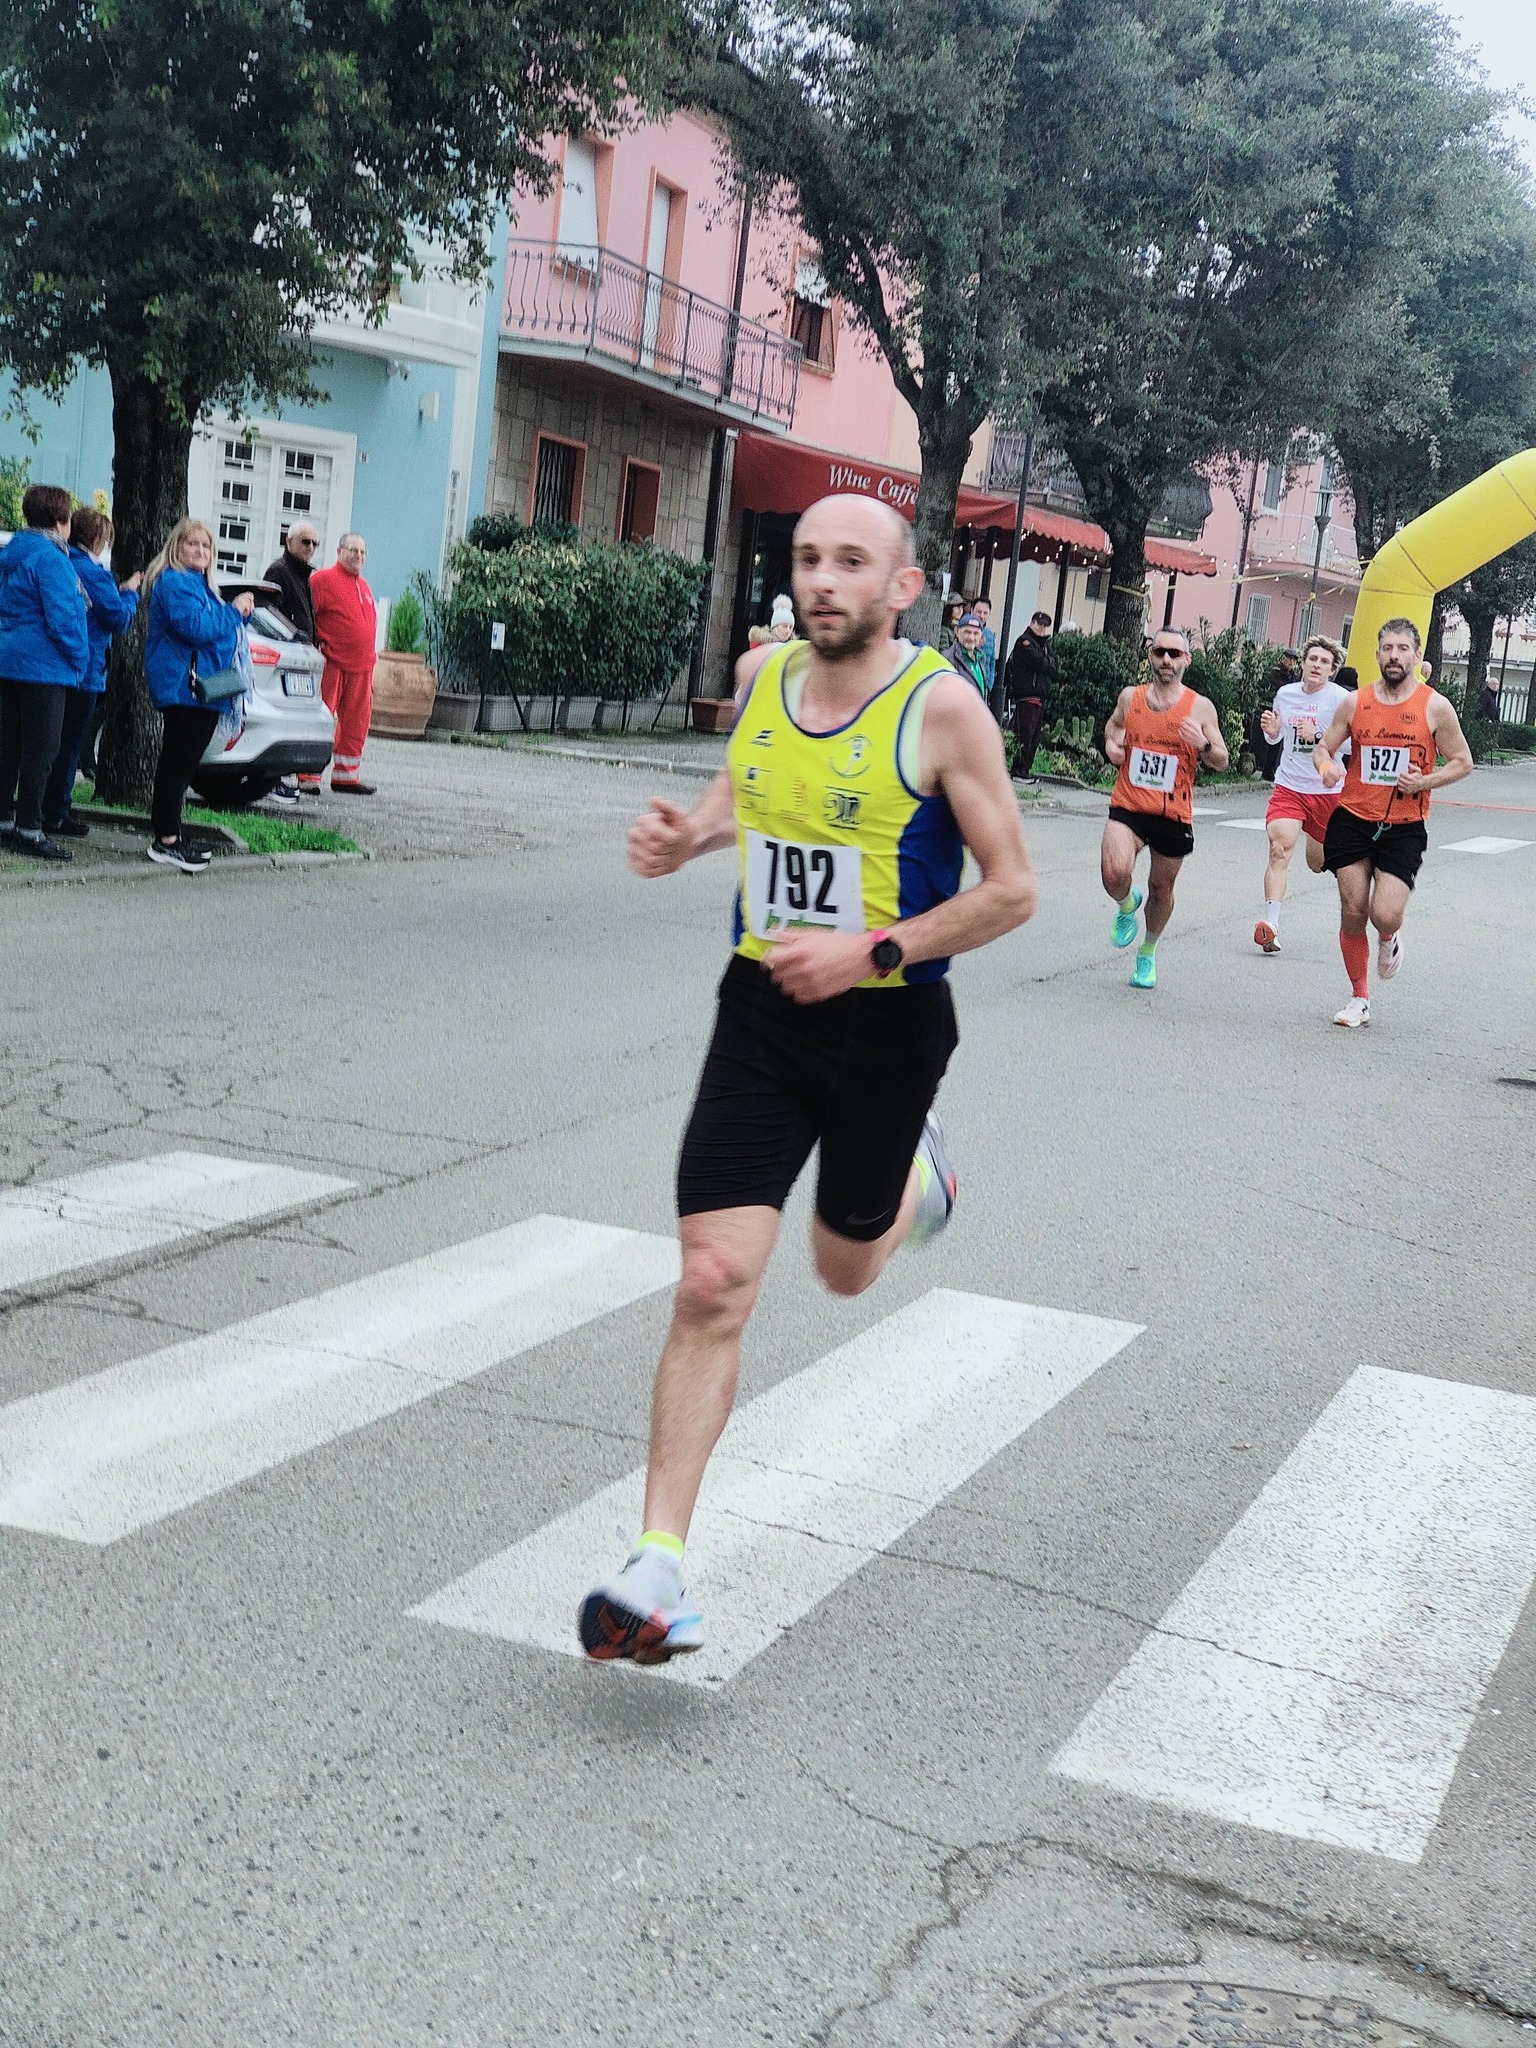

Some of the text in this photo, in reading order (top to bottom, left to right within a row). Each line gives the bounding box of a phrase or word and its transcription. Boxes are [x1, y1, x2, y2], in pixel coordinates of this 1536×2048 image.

[829, 463, 872, 490] Wine
[1139, 751, 1168, 779] 531
[1370, 748, 1401, 772] 527
[764, 840, 838, 914] 792
